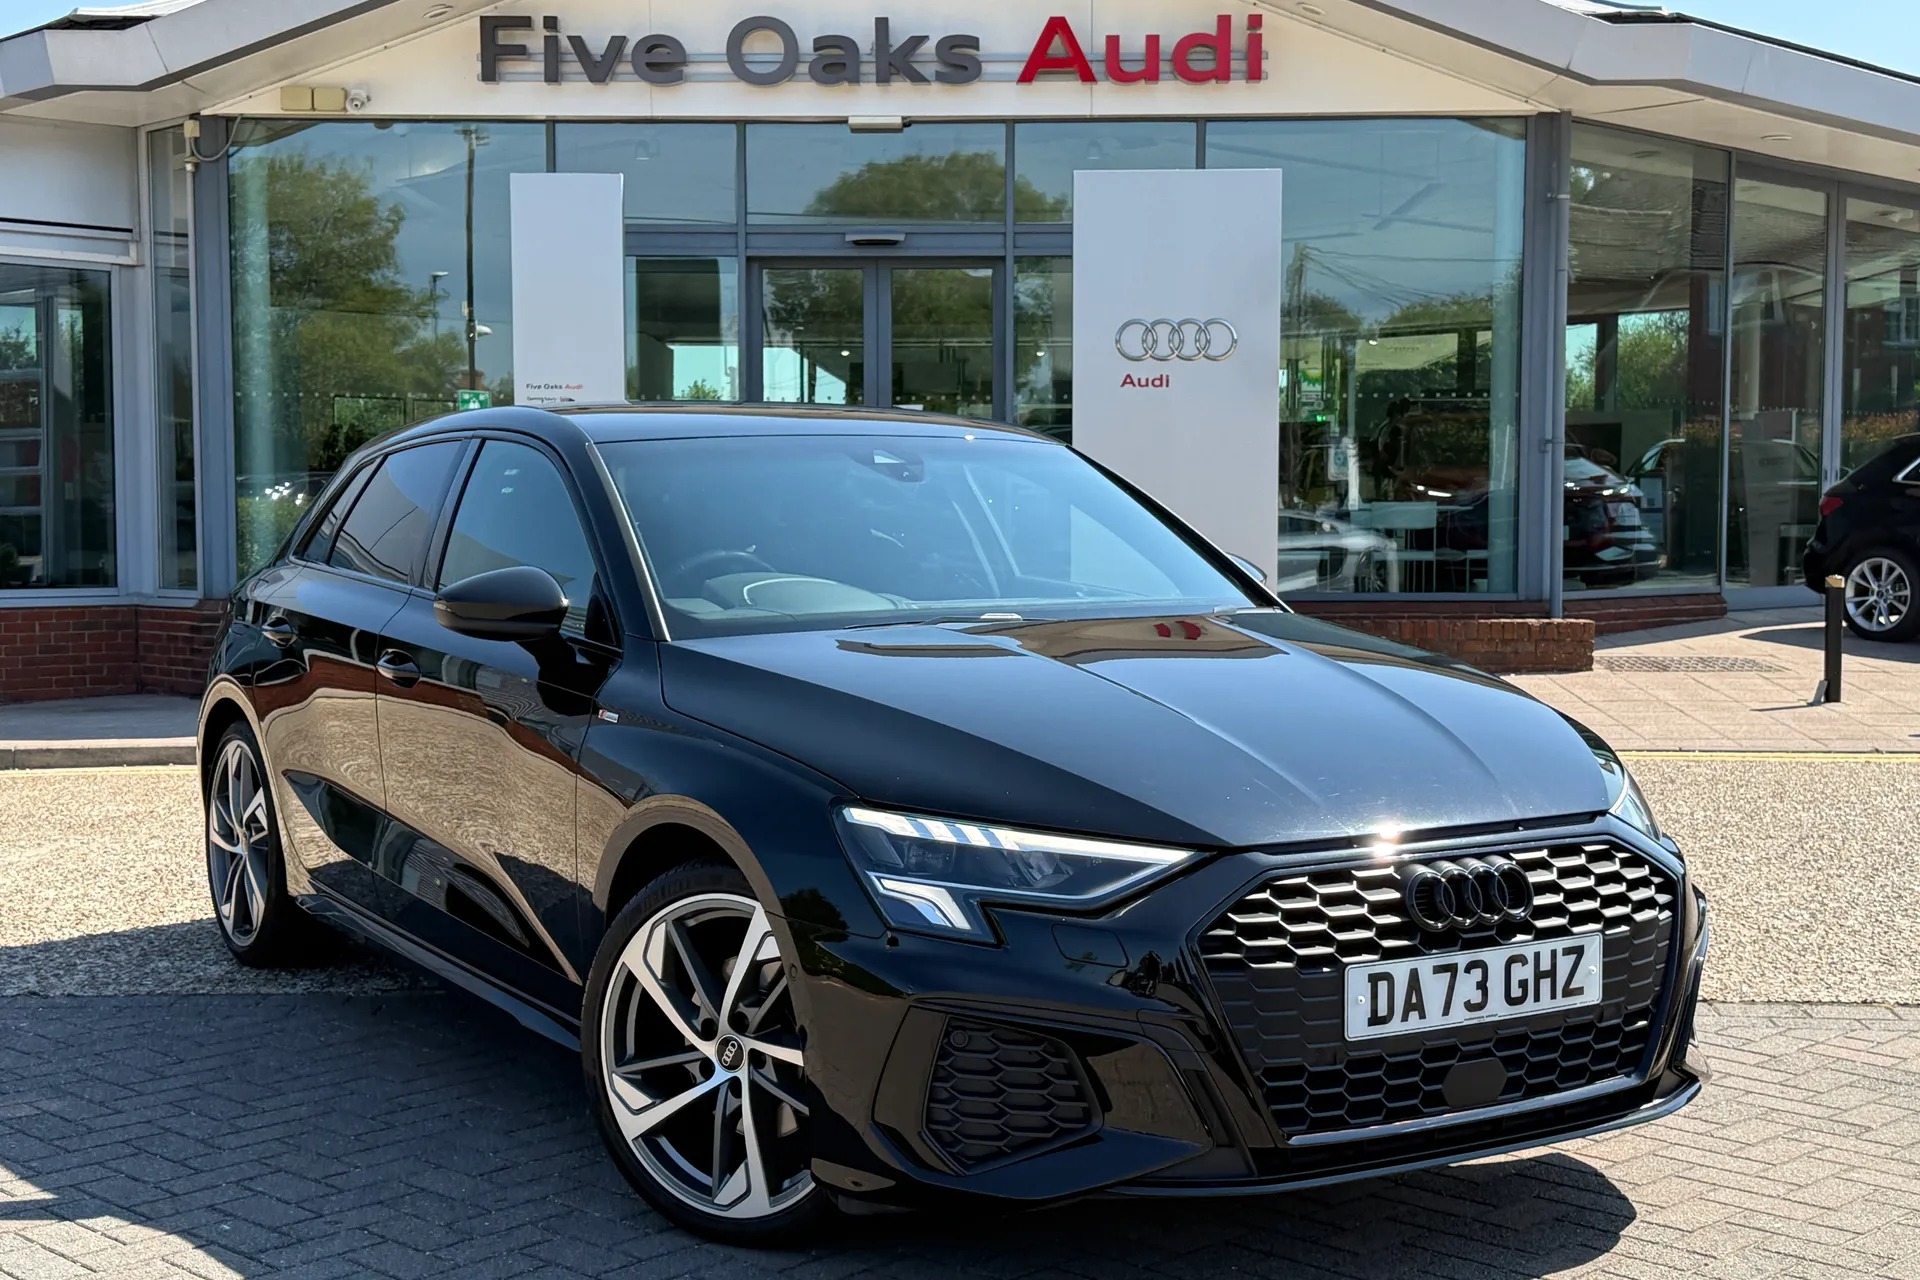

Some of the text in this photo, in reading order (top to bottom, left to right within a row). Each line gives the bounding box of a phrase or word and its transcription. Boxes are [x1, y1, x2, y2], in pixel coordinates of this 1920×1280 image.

[480, 14, 1263, 86] Five Oaks Audi
[1120, 374, 1170, 388] Audi
[1367, 945, 1585, 1027] DA73 GHZ
